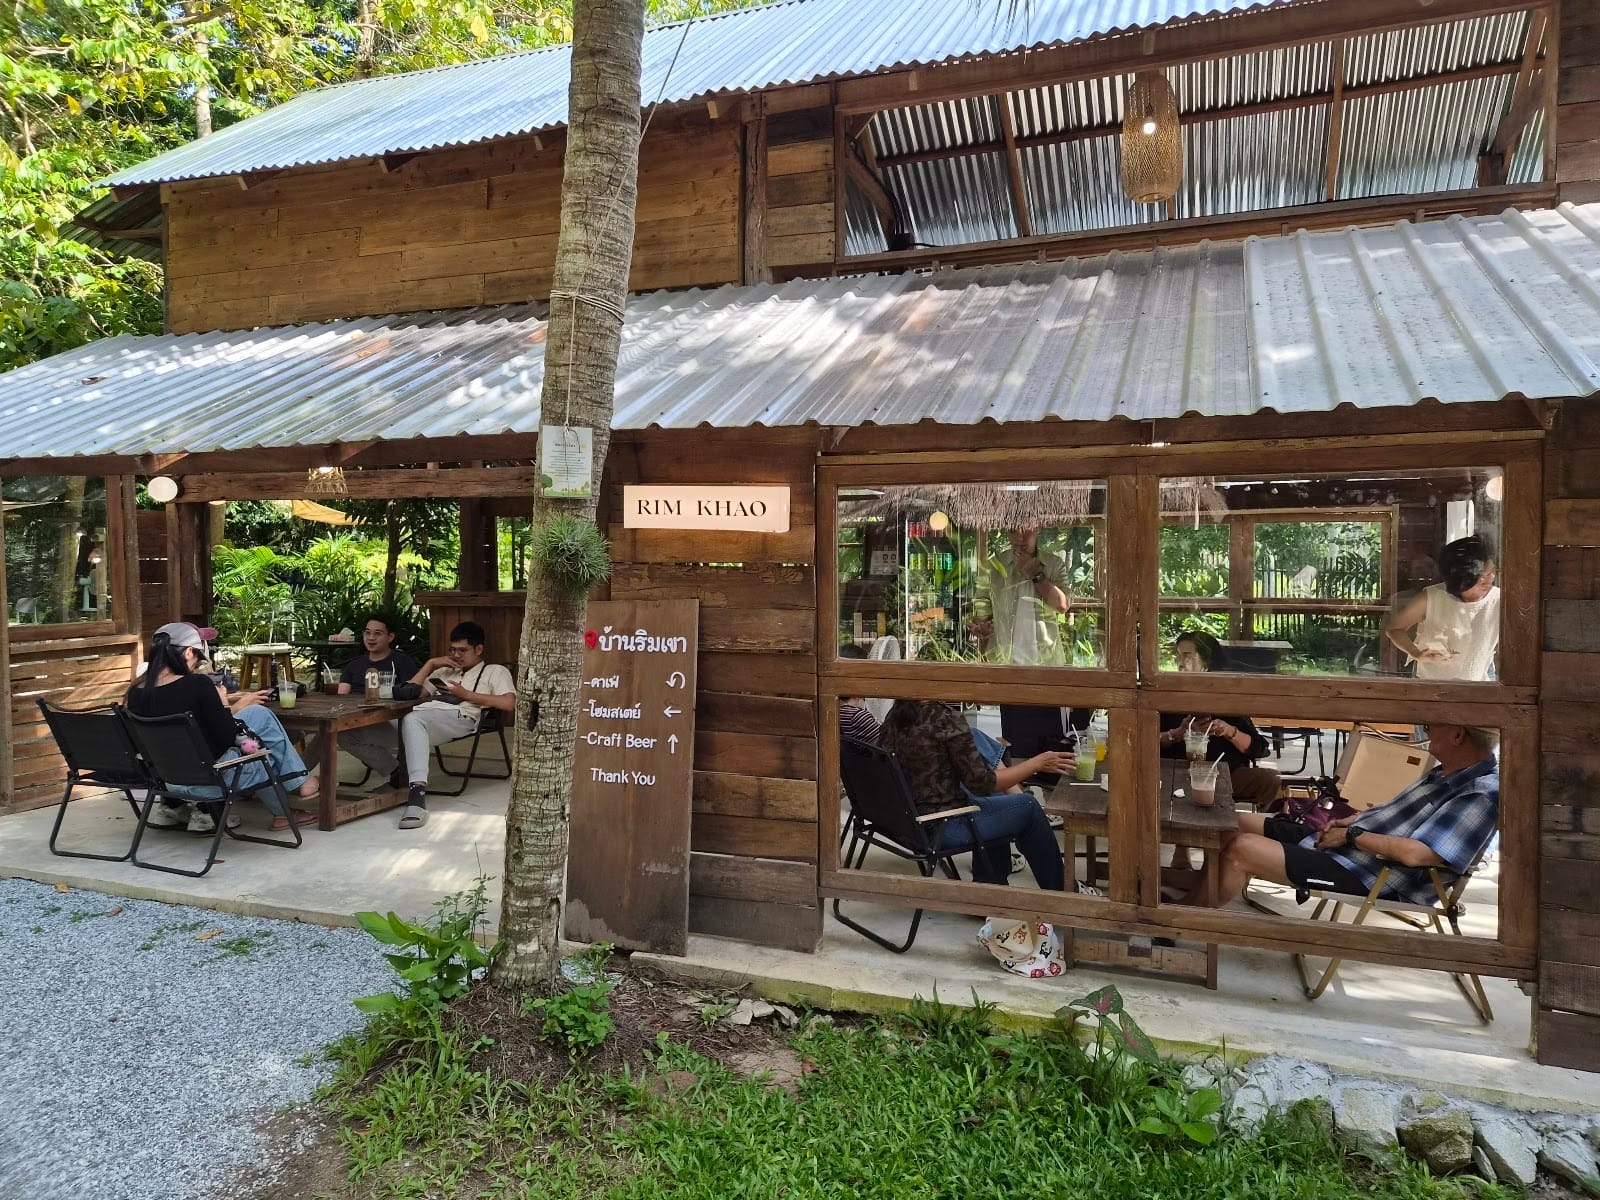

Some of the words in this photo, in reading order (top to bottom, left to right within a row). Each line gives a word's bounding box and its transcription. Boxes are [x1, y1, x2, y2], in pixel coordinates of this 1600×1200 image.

[637, 499, 682, 516] RIM
[697, 500, 767, 517] KHAO
[598, 625, 687, 653] บ้านริมเขา
[365, 671, 379, 689] 13
[625, 734, 658, 749] Beer
[590, 767, 629, 784] Thank
[631, 771, 656, 786] You
